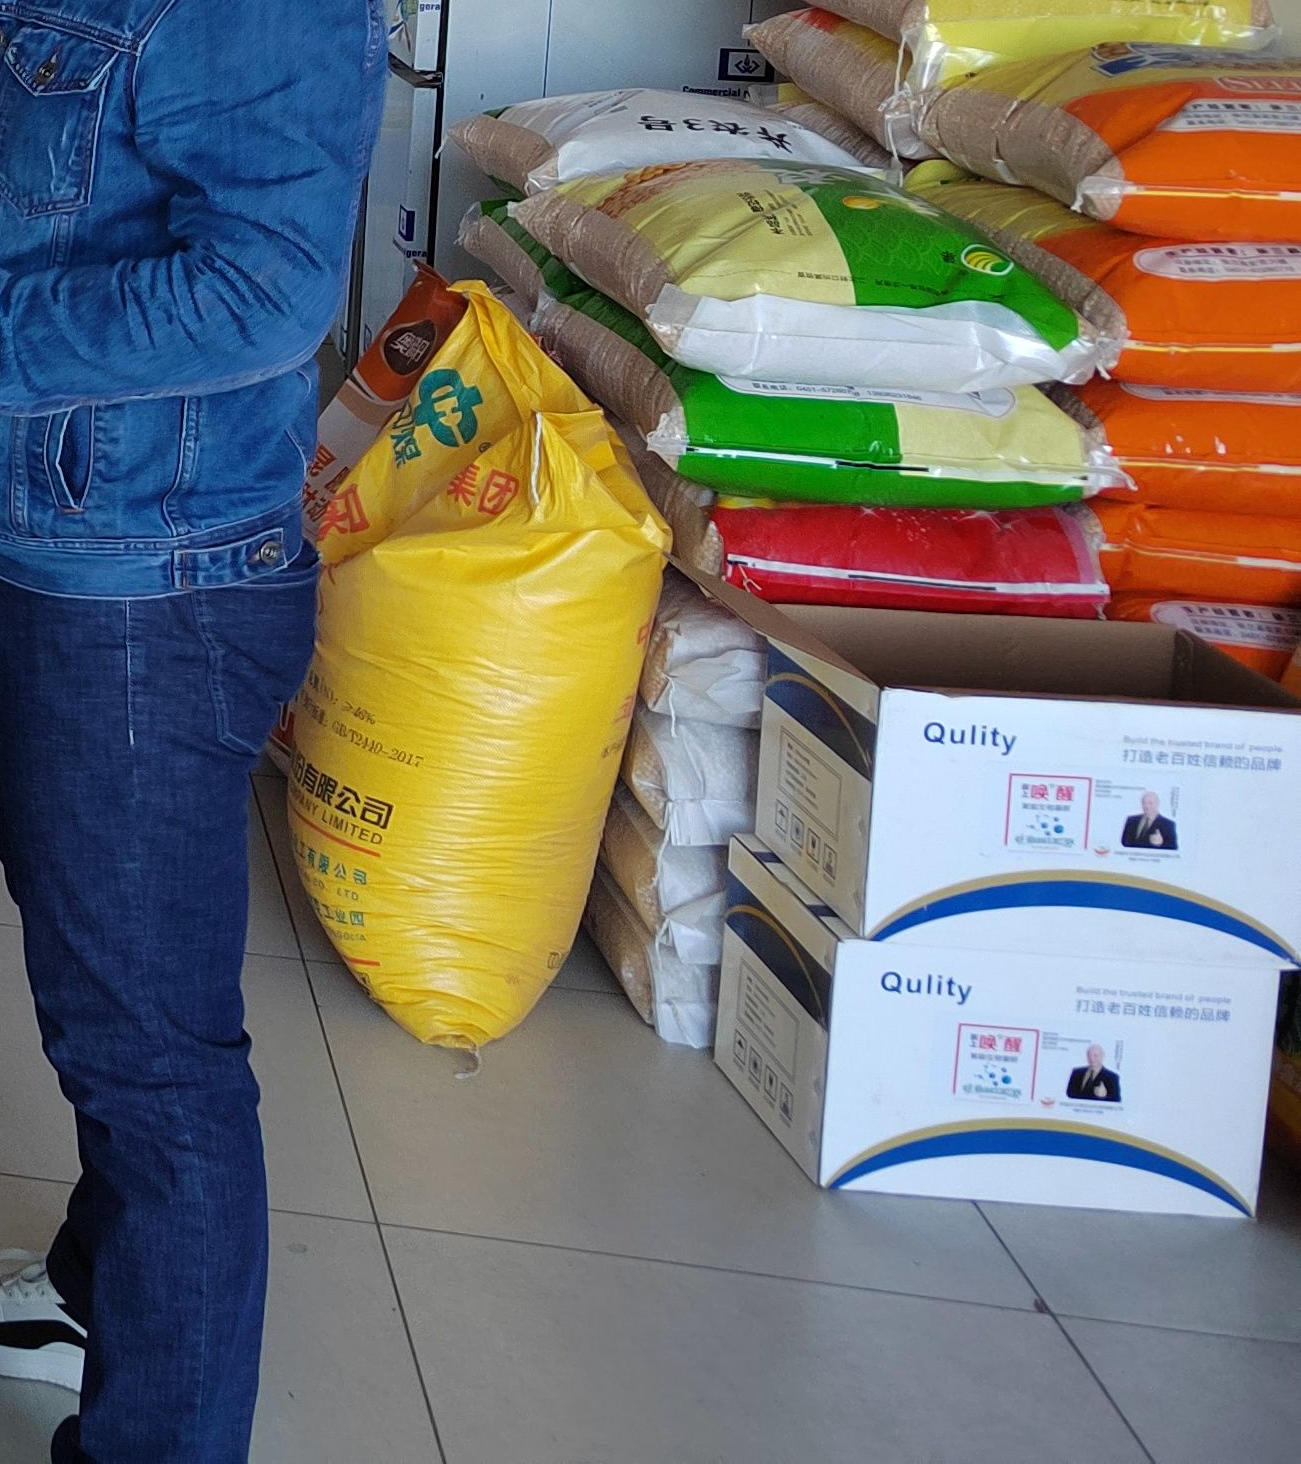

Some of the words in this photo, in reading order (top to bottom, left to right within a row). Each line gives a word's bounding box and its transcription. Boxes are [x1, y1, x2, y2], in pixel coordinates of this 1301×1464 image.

[682, 84, 741, 98] Commercial
[447, 462, 520, 517] 集团
[923, 721, 1018, 755] Qulity
[1122, 748, 1282, 772] 打造老百姓信赖的品牌
[321, 808, 384, 845] LIMITED
[881, 971, 973, 1005] Qulity
[1075, 999, 1232, 1022] 打造老百姓信赖的品牌
